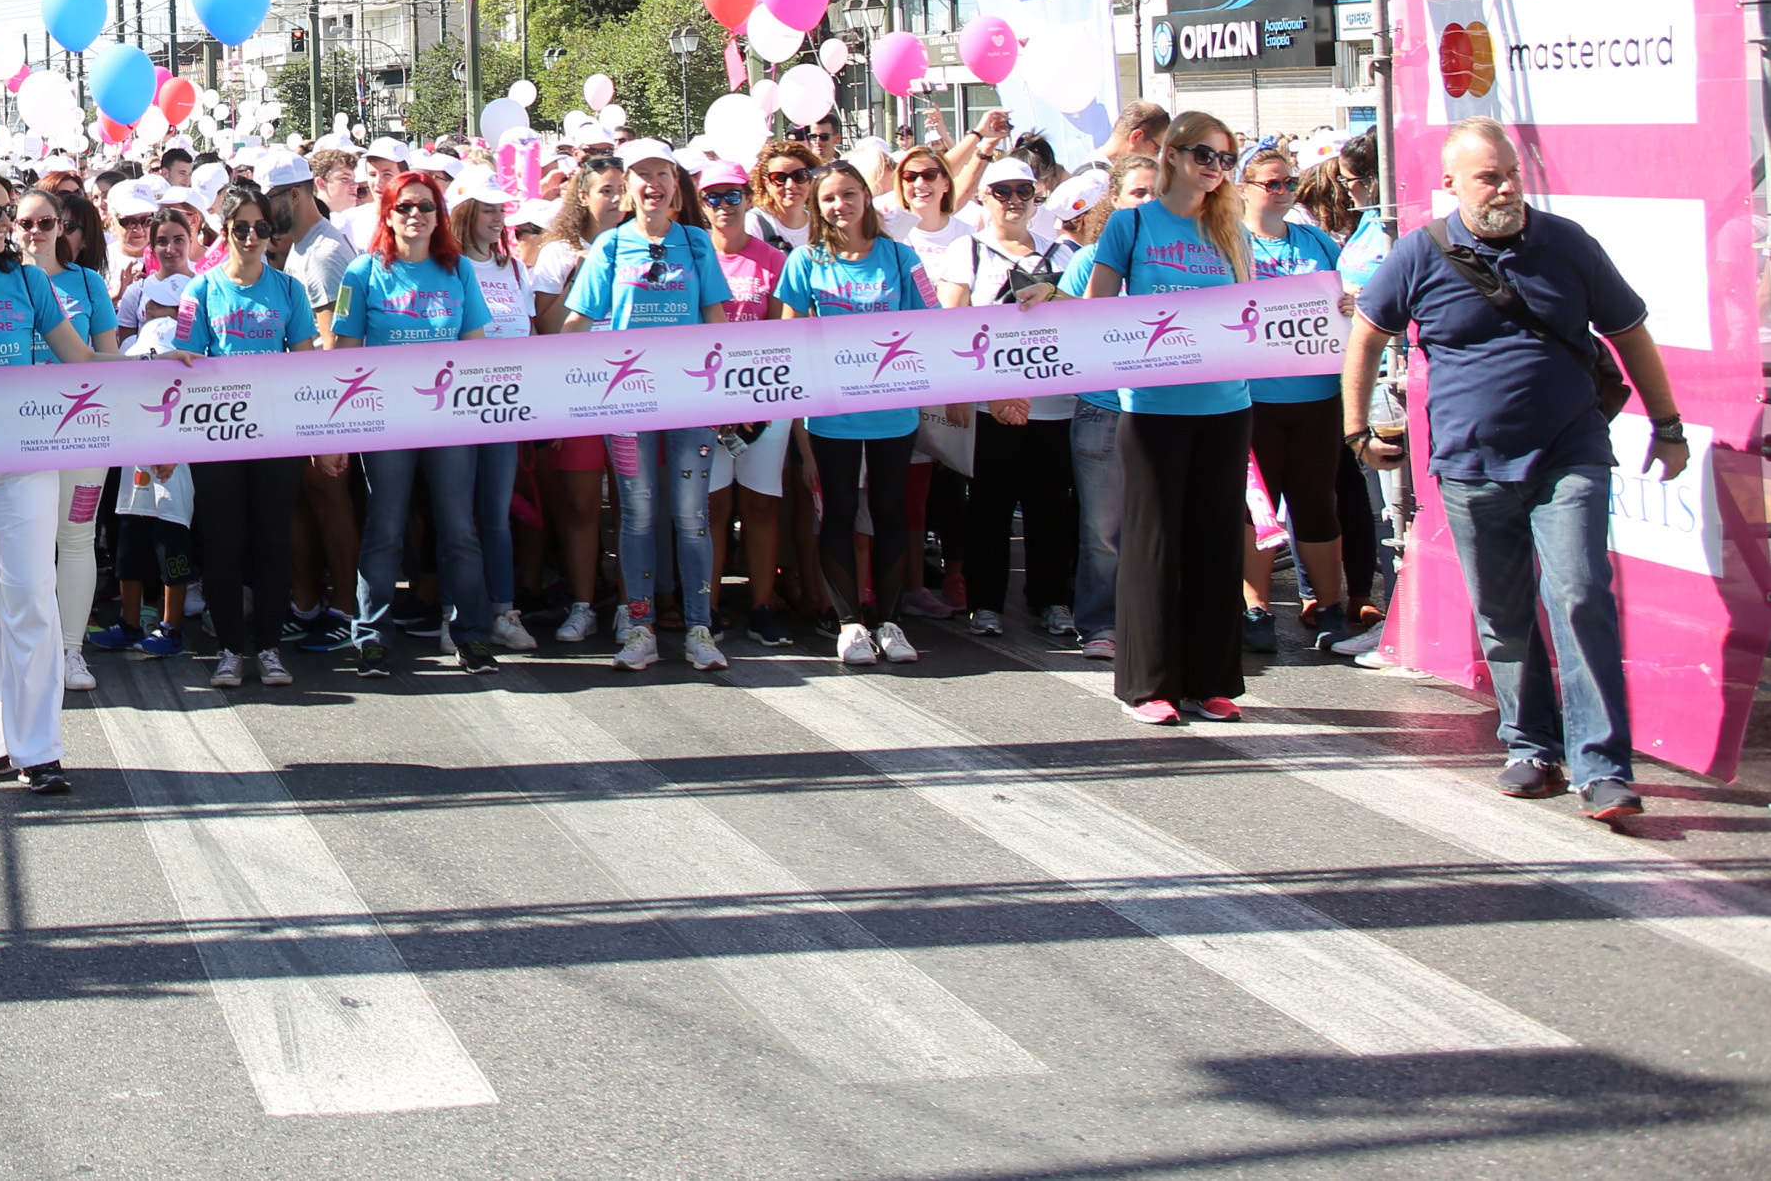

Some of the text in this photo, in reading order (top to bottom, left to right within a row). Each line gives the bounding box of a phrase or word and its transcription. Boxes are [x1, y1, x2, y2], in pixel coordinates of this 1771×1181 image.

[1180, 20, 1259, 60] ΟΡΙΖΩΝ
[1508, 25, 1674, 73] mastercard
[664, 303, 687, 312] 2019
[1264, 317, 1329, 339] race
[992, 346, 1060, 365] race
[724, 365, 791, 387] race
[453, 384, 520, 407] race
[180, 401, 248, 424] race
